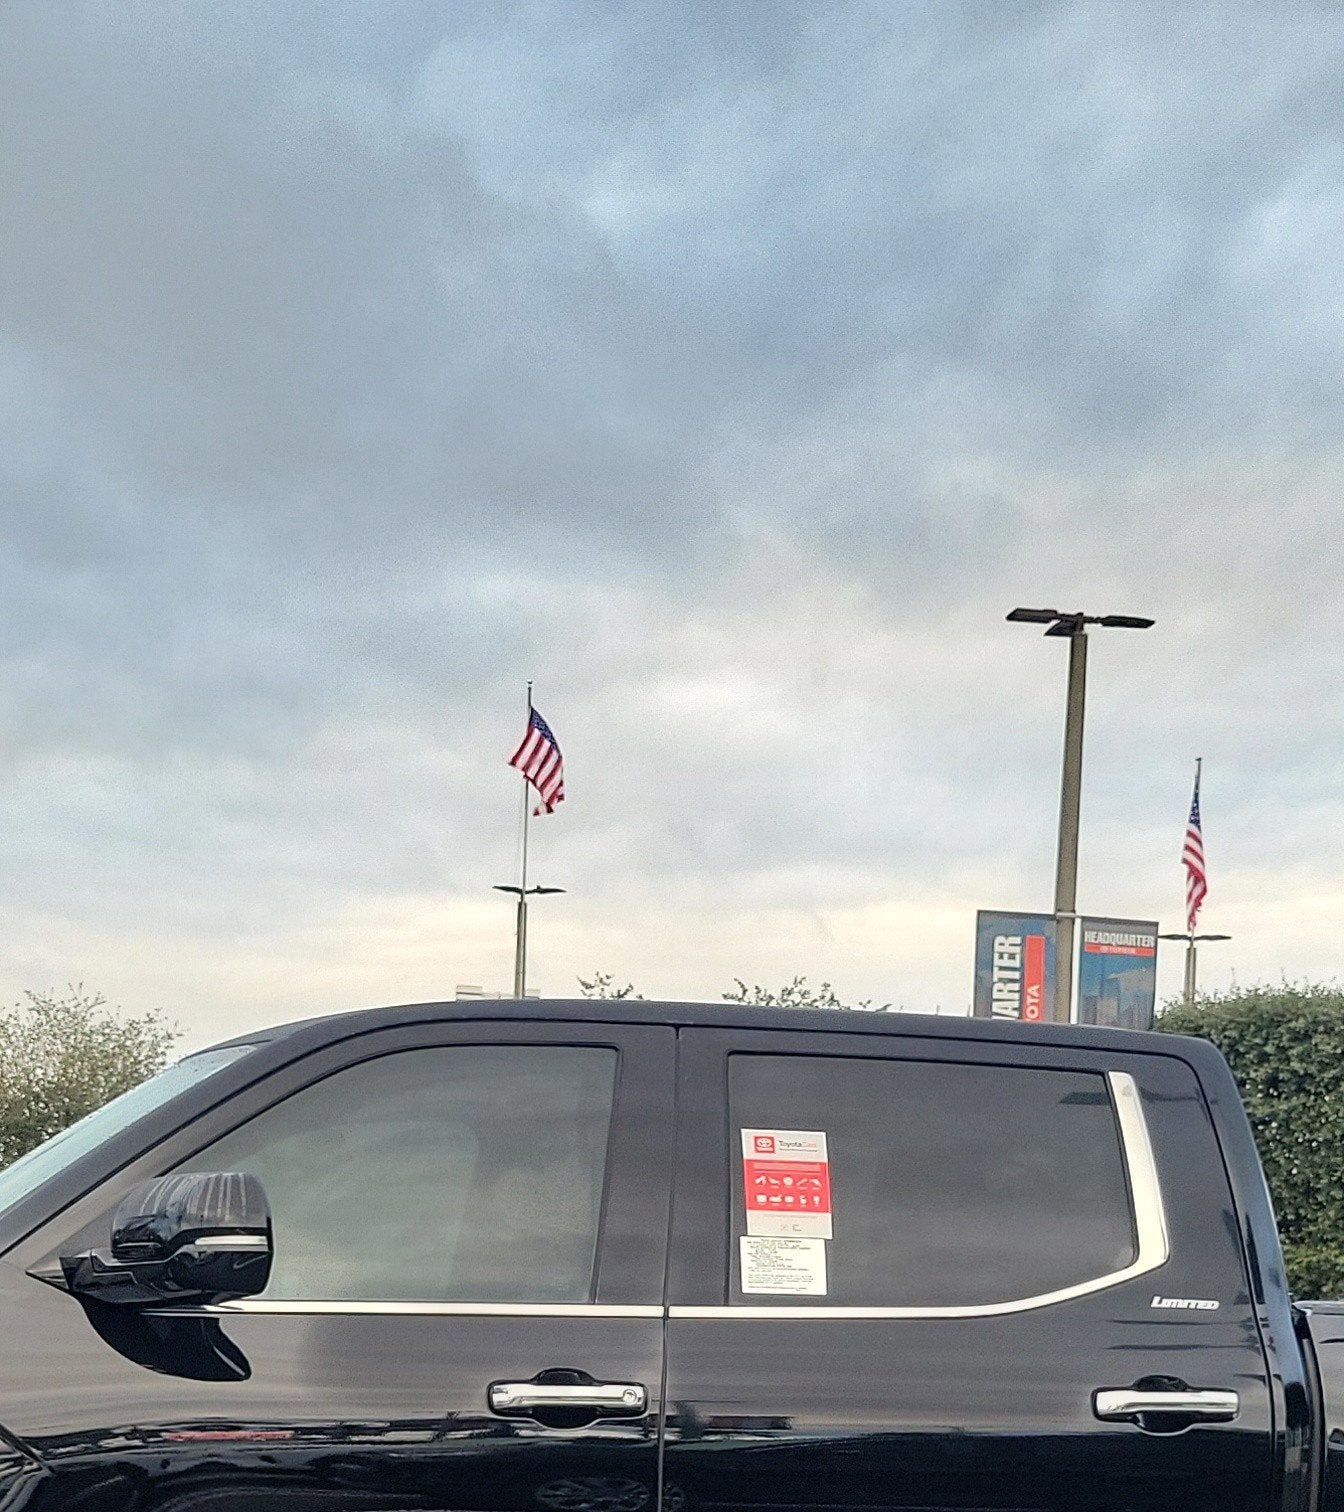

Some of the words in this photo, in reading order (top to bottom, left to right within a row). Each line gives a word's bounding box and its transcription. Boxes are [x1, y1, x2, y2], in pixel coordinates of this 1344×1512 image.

[1085, 931, 1155, 947] HEADQUARTER
[991, 934, 1022, 1020] ARTER
[1026, 984, 1041, 1021] OTA
